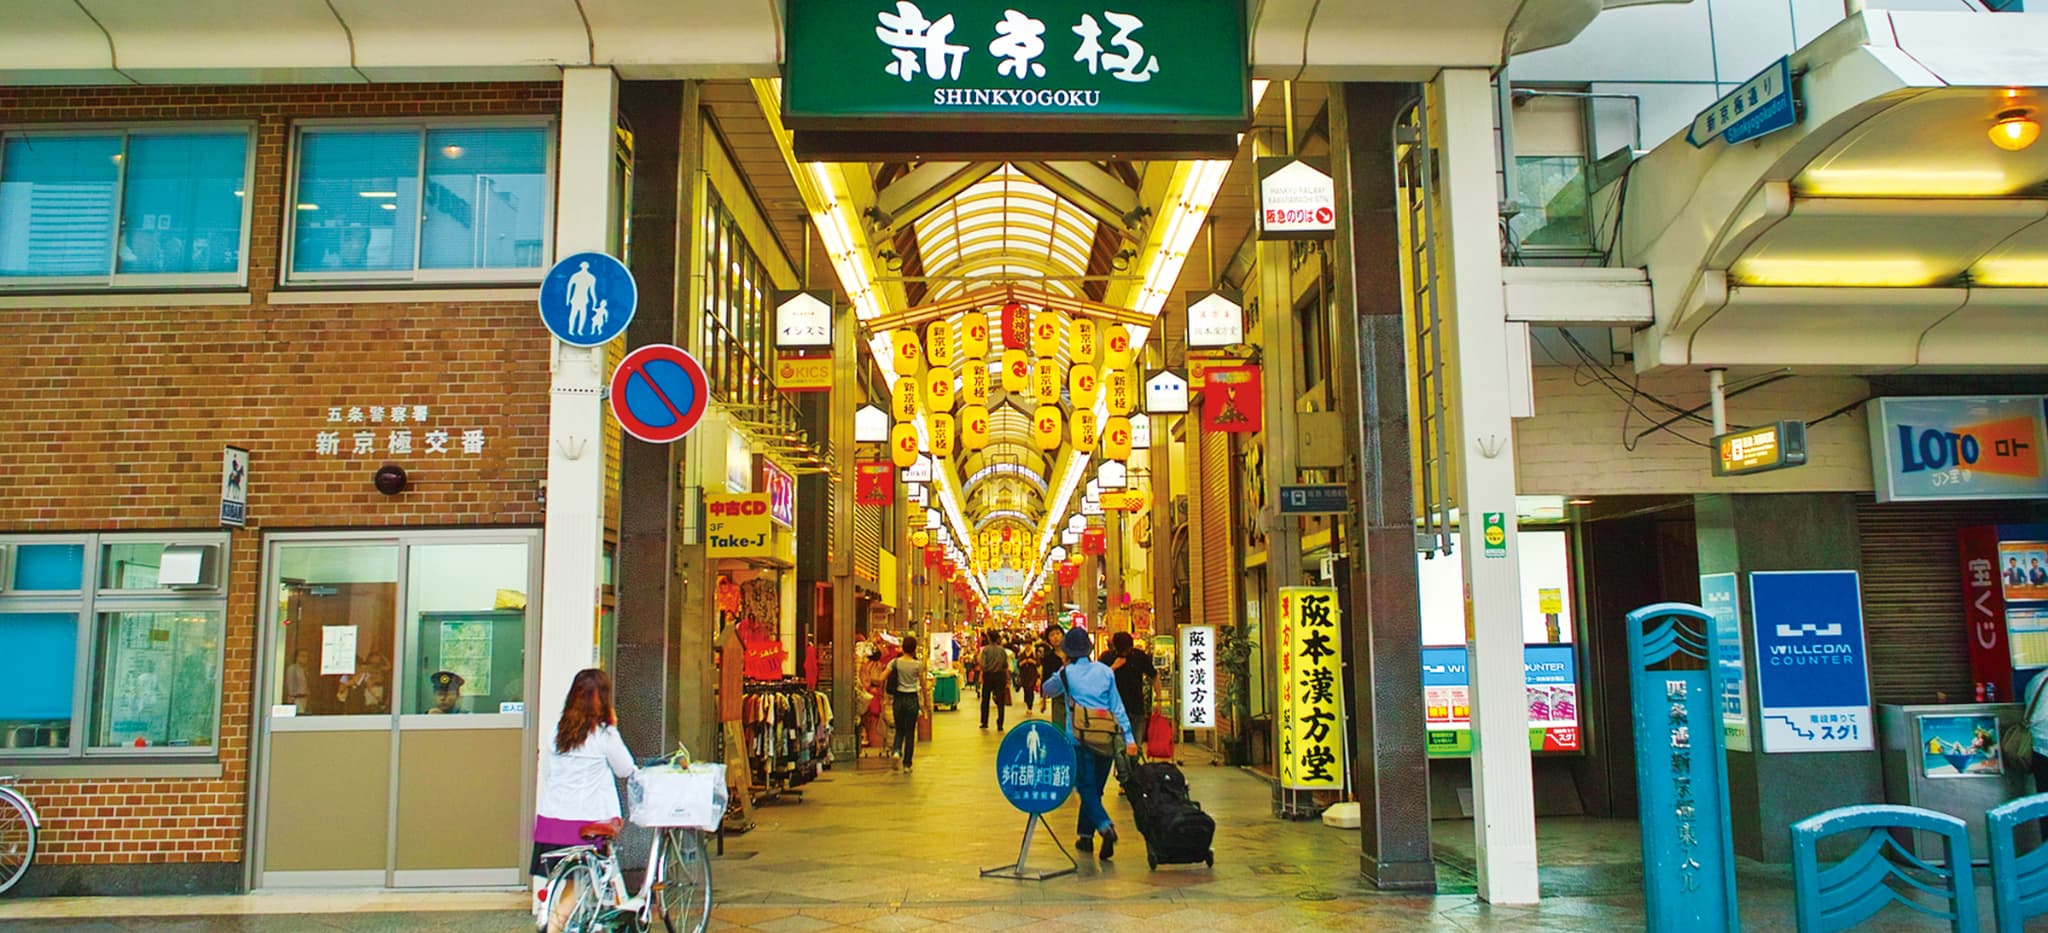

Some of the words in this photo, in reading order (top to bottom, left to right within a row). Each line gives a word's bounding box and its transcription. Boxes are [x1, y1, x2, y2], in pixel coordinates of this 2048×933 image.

[875, 1, 1160, 82] 新京極
[934, 88, 1100, 106] SHINKYOGOKU
[1706, 76, 1771, 133] 新京極通り
[933, 326, 946, 358] 新京極
[1080, 323, 1092, 356] 新京極
[796, 366, 829, 378] KICS
[974, 365, 985, 398] 新京極
[1040, 365, 1052, 397] 新京極
[903, 382, 915, 416] 新京極
[1114, 375, 1126, 409] 新京極
[326, 405, 428, 422] 五条警察署
[315, 429, 486, 455] 新京極交番
[935, 419, 947, 450] 新京極
[1082, 415, 1094, 446] 新京極
[1897, 424, 1979, 473] LOTO
[709, 500, 767, 516] 中古CD
[710, 523, 724, 531] 3F
[710, 533, 766, 548] Take-J
[1968, 557, 1997, 650] 宝くじ
[1770, 644, 1852, 655] WILLCOM
[1770, 655, 1854, 666] COUNTER
[1189, 631, 1207, 725] 阪本漢方堂
[1525, 663, 1565, 672] OUNTER
[1300, 594, 1336, 782] 阪本漢方堂
[1821, 725, 1858, 740] スグ!
